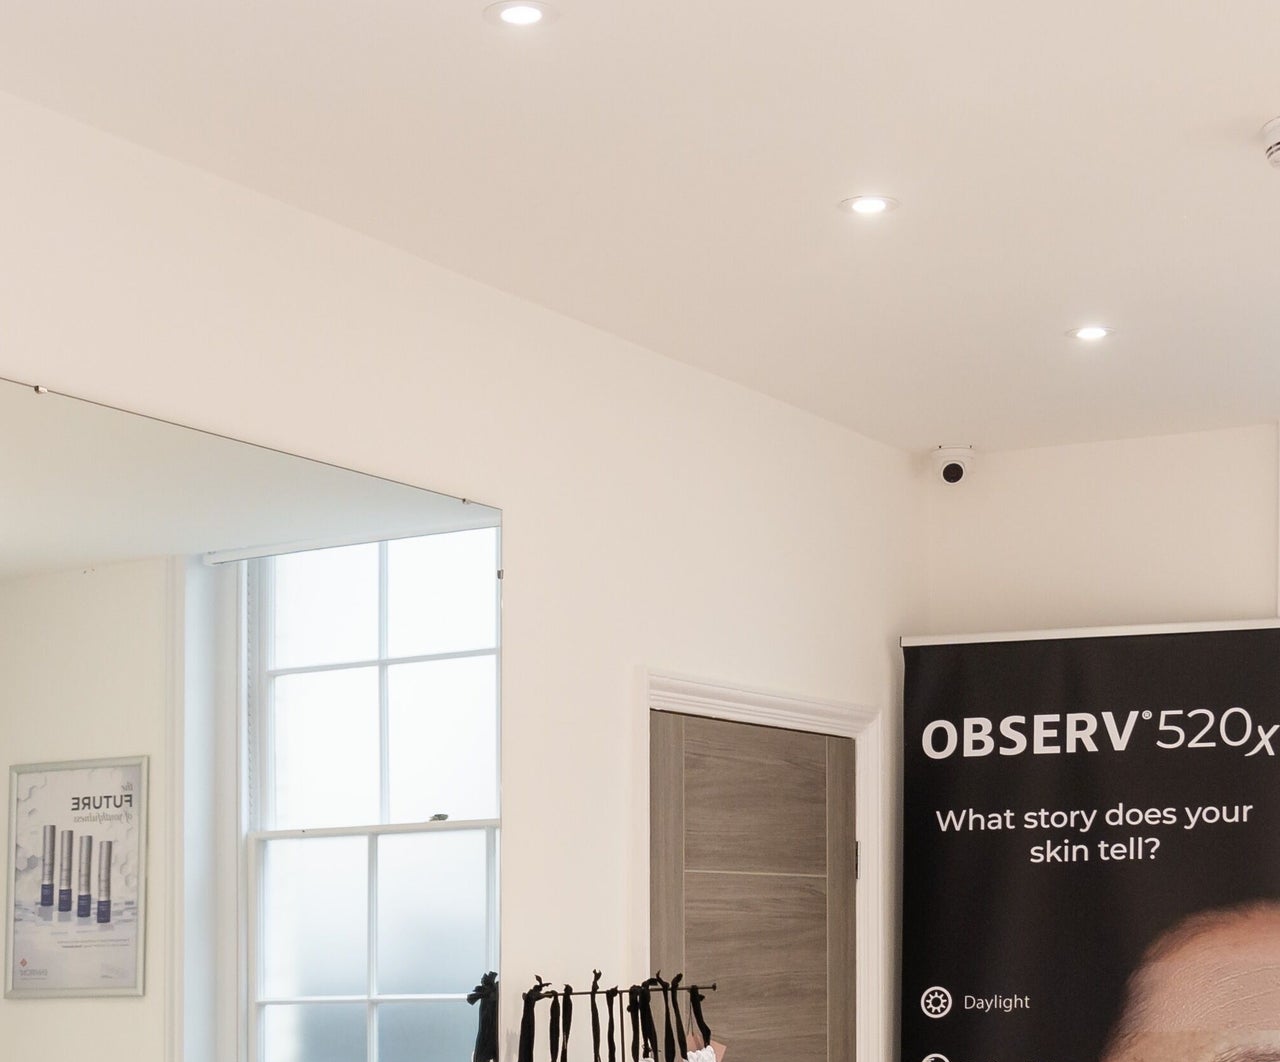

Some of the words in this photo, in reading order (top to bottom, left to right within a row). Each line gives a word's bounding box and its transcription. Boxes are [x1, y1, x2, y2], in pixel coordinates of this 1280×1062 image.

[935, 805, 1016, 832] What
[1023, 807, 1098, 833] story
[1104, 801, 1178, 826] does
[1184, 801, 1254, 830] your
[1029, 838, 1089, 863] skin
[1098, 836, 1161, 861] tell?
[963, 993, 1031, 1013] Daylight
